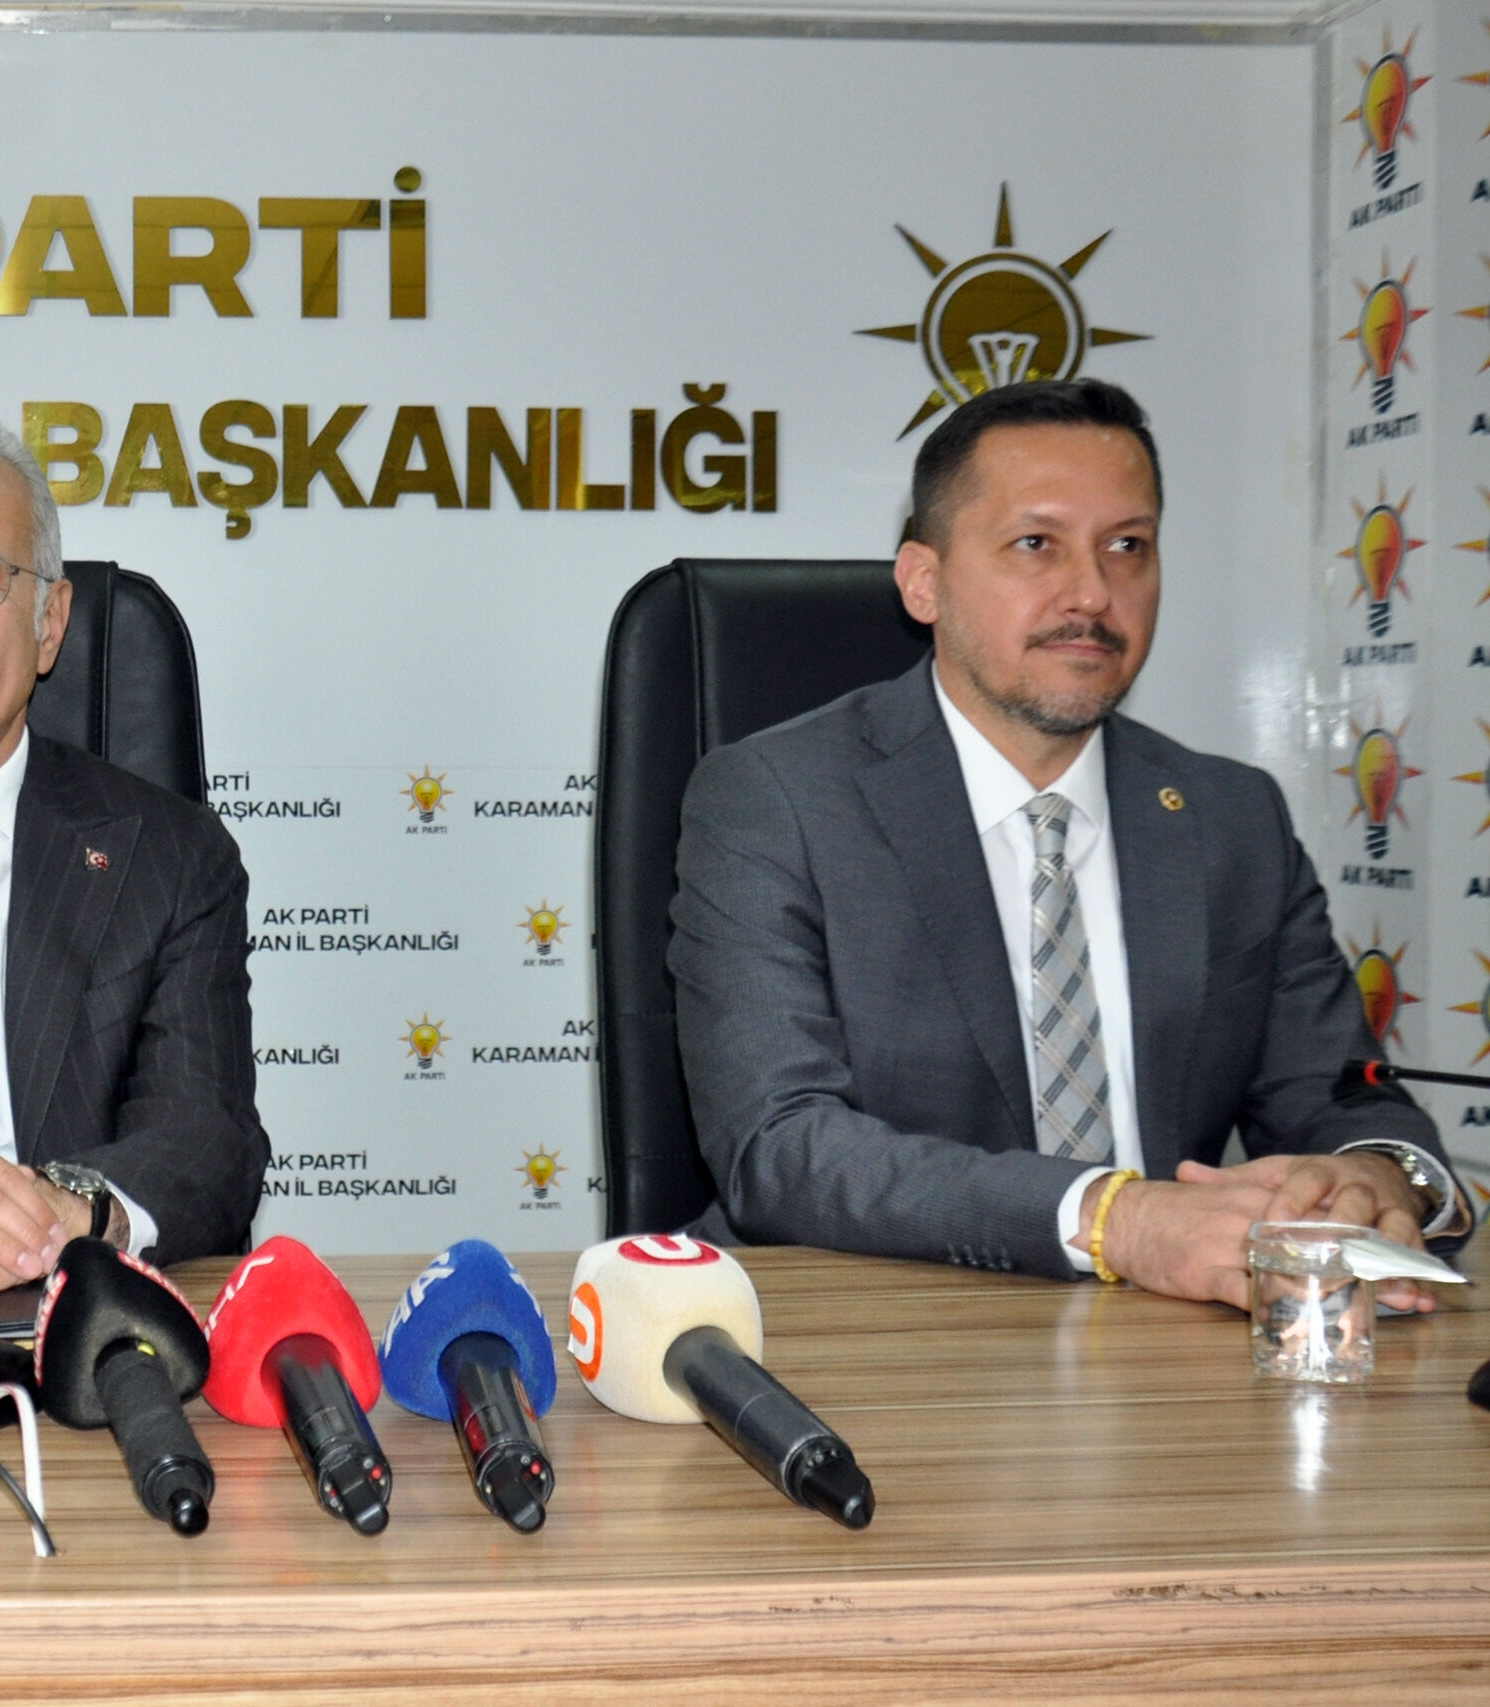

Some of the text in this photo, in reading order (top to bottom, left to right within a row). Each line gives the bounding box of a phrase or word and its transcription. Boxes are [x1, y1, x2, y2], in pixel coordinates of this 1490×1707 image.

[1470, 178, 1490, 203] A
[1467, 412, 1490, 436] A
[22, 383, 778, 541] BAŞKANLIĞI
[1466, 645, 1490, 668] A
[564, 774, 598, 791] AK
[474, 801, 593, 818] KARAMAN
[406, 826, 418, 834] AK
[1463, 876, 1490, 899] A
[262, 904, 369, 925] AK PARTİ
[296, 931, 315, 951] İL
[320, 930, 459, 955] BAŞKANLIĞI
[562, 1020, 596, 1037] AK
[253, 1044, 339, 1065] KANLIĞI
[472, 1046, 591, 1064] KARAMAN
[404, 1072, 417, 1081] AK
[268, 1150, 367, 1171] AK PARTİ
[294, 1176, 314, 1196] İL
[318, 1175, 456, 1201] BAŞKANLIĞI
